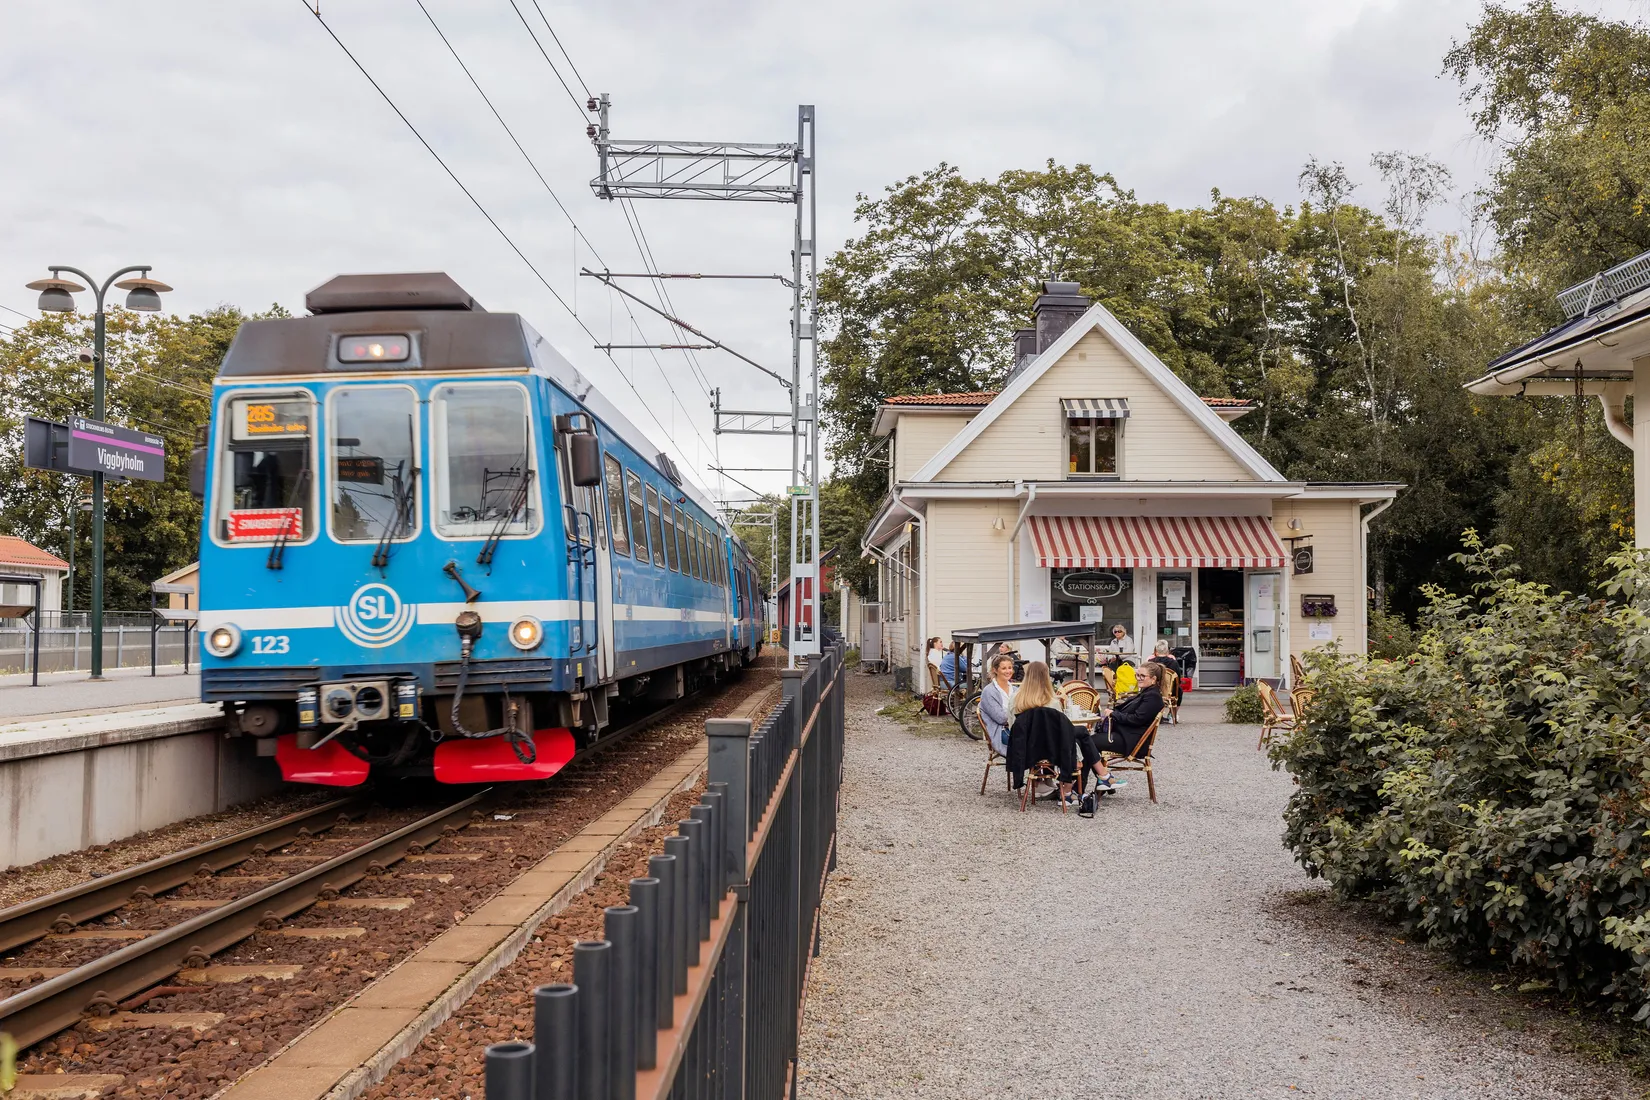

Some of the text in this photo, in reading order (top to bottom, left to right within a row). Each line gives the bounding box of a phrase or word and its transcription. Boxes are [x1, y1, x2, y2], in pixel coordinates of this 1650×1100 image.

[97, 447, 144, 472] Viggbyholm
[358, 595, 394, 620] SL
[251, 635, 290, 654] 123
[773, 632, 779, 640] 3
